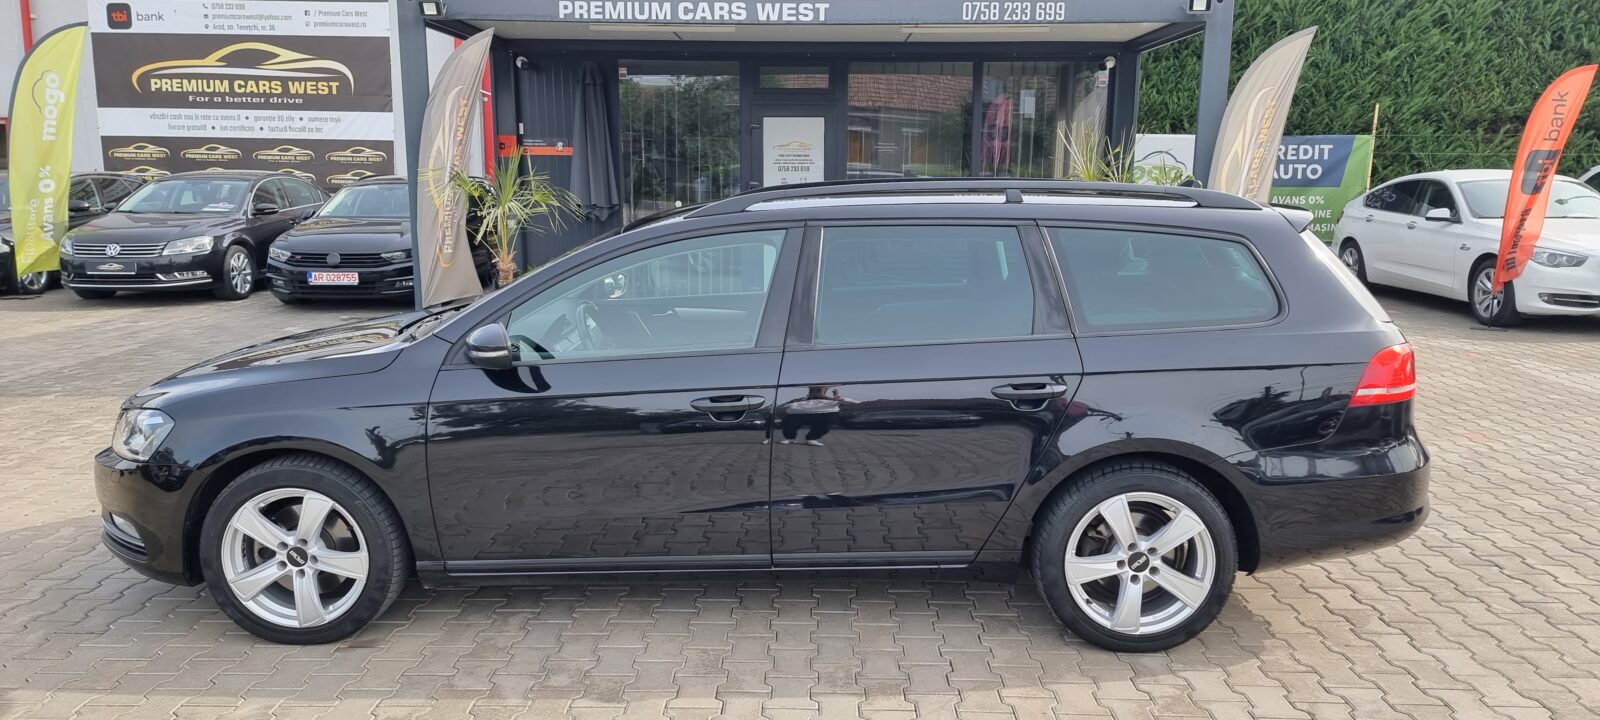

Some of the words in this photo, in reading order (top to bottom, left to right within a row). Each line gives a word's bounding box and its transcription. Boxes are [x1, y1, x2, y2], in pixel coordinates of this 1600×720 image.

[111, 10, 128, 22] tbi
[136, 11, 165, 22] bank
[558, 1, 671, 20] PREMIUM
[677, 1, 747, 21] CARS
[756, 2, 830, 22] WEST
[962, 1, 999, 21] 0758
[1003, 1, 1031, 21] 233
[1035, 1, 1066, 21] 699
[150, 78, 230, 93] PREMIUM
[233, 79, 283, 94] CARS
[288, 81, 340, 95] WEST
[42, 71, 65, 142] mogo
[269, 96, 304, 104] drive
[1543, 90, 1570, 142] bank
[1278, 144, 1333, 160] REDIT
[1271, 195, 1306, 205] AVANS
[1308, 195, 1325, 205] 0%
[313, 273, 324, 282] AR
[325, 273, 357, 282] 028755
